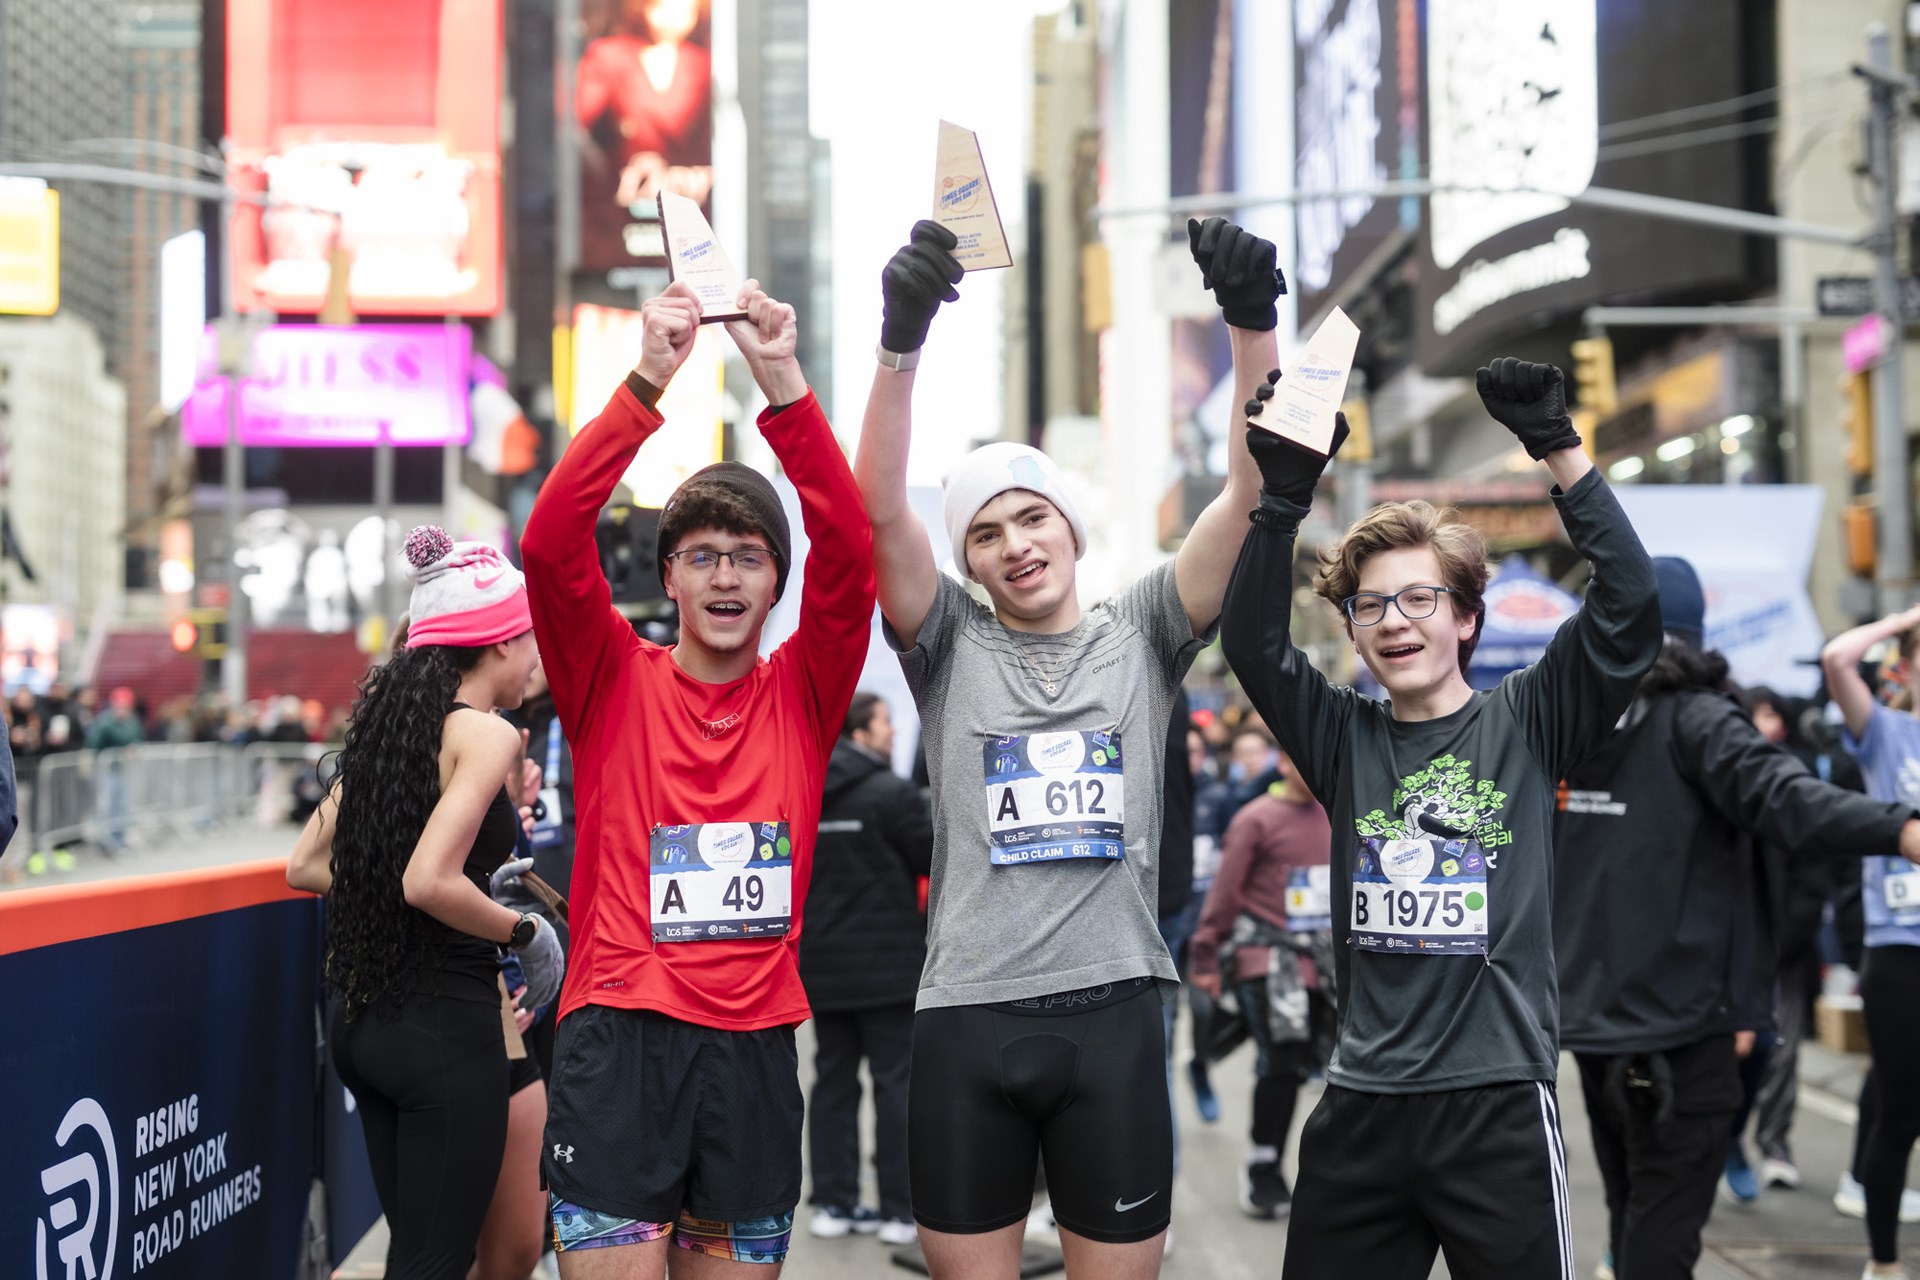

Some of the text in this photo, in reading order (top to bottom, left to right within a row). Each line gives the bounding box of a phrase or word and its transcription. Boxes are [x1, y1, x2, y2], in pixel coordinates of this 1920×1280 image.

[941, 178, 980, 203] TIMES SQUARE
[996, 779, 1106, 821] A 612
[1000, 851, 1029, 862] CHILD
[1030, 848, 1064, 859] CLAIM
[1072, 844, 1091, 855] 612
[660, 875, 764, 915] A 49
[1356, 889, 1465, 928] B 1975
[135, 1093, 199, 1159] RISING
[134, 1131, 228, 1216] NEW YORK
[132, 1164, 262, 1274] ROAD RUNNERS
